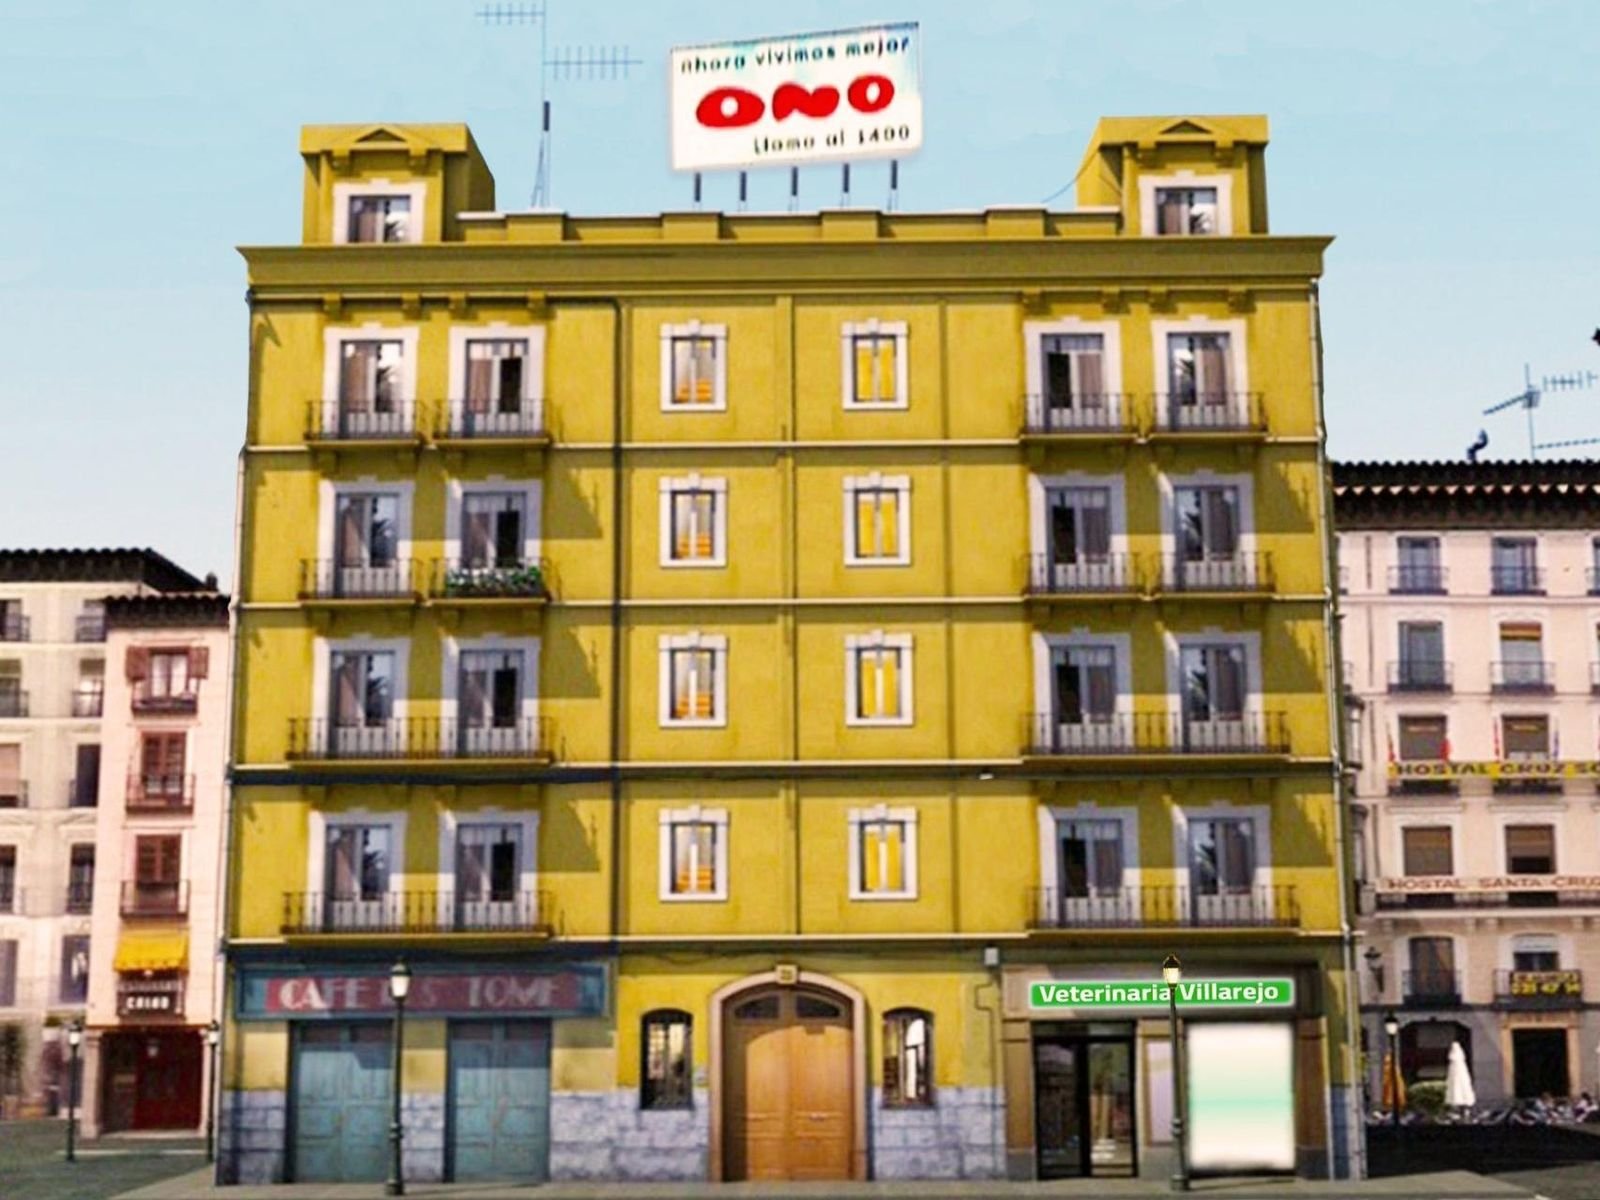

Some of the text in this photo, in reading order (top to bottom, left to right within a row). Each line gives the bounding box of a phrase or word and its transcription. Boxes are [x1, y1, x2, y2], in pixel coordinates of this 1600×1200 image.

[755, 43, 836, 66] vivimos
[846, 36, 909, 58] mejor
[696, 74, 895, 130] ONO
[825, 128, 845, 146] al
[858, 124, 910, 145] 1400
[1396, 763, 1488, 776] HOSTAL
[1039, 982, 1279, 1004] Veterinaria Villarejo
